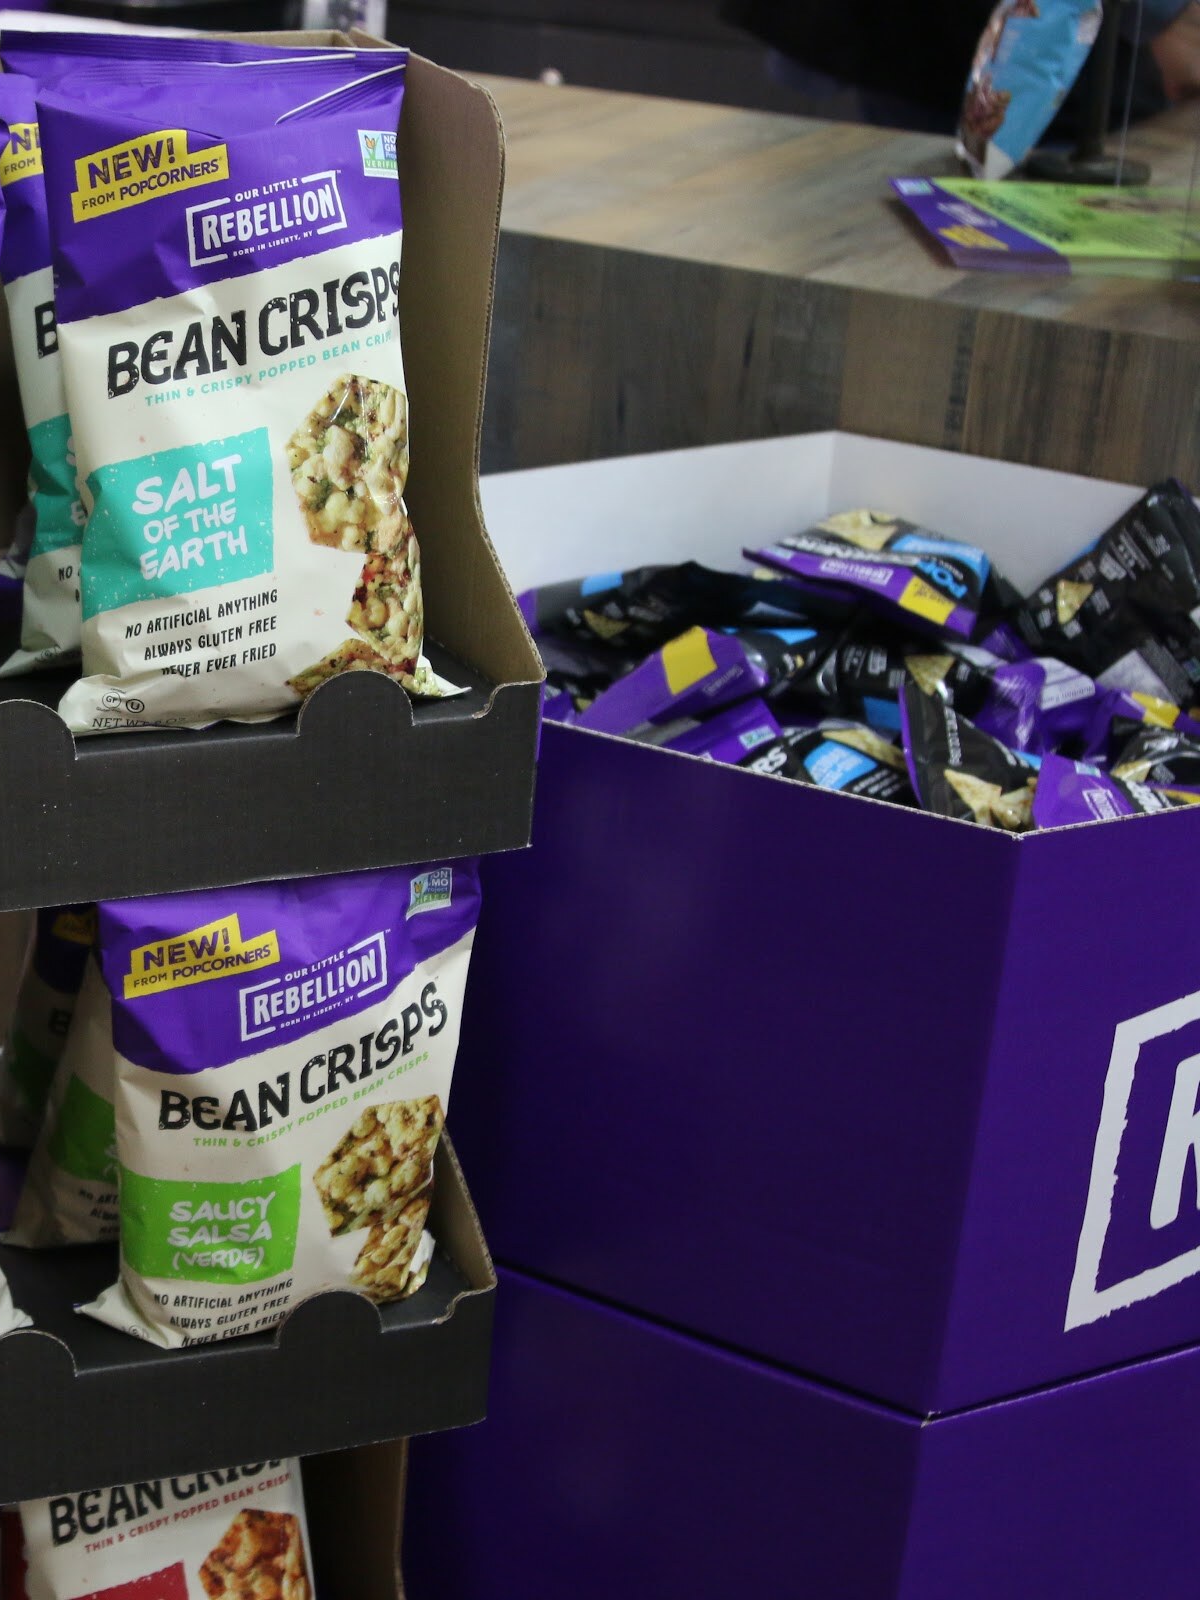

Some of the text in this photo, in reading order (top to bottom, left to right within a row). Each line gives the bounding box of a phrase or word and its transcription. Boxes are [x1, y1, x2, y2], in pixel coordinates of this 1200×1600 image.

[81, 159, 220, 210] FROM POPCORNERS
[87, 137, 176, 189] NEW!
[235, 177, 298, 202] OUR LITTLE
[107, 310, 247, 399] BEAN
[200, 372, 252, 394] CRISPY
[258, 354, 316, 381] POPPED
[323, 340, 360, 360] BEAN
[132, 454, 242, 515] SALT
[143, 498, 237, 544] OF THE
[139, 525, 248, 581] EARTH
[147, 589, 278, 634] ARTIFICIAL ANYTHING
[144, 615, 277, 661] ALWAYS GLUTEN FREE
[206, 643, 276, 674] EVER FRIED
[134, 944, 271, 988] FROM POPCORNERS
[143, 927, 229, 970] NEW!
[285, 950, 345, 981] OUR LITTLE
[159, 981, 447, 1131] BEAN CRISPS
[247, 1051, 429, 1146] CRISPY POPPED BEAN CRISPS
[169, 1191, 276, 1224] SAUCY
[167, 1221, 273, 1247] SALSA
[172, 1247, 264, 1270] (VERDE)
[170, 1295, 290, 1329] ALWAYS GLUTEN FREE
[173, 1277, 293, 1309] ARTIFICIAL ANYTHING
[223, 1320, 250, 1339] EVER
